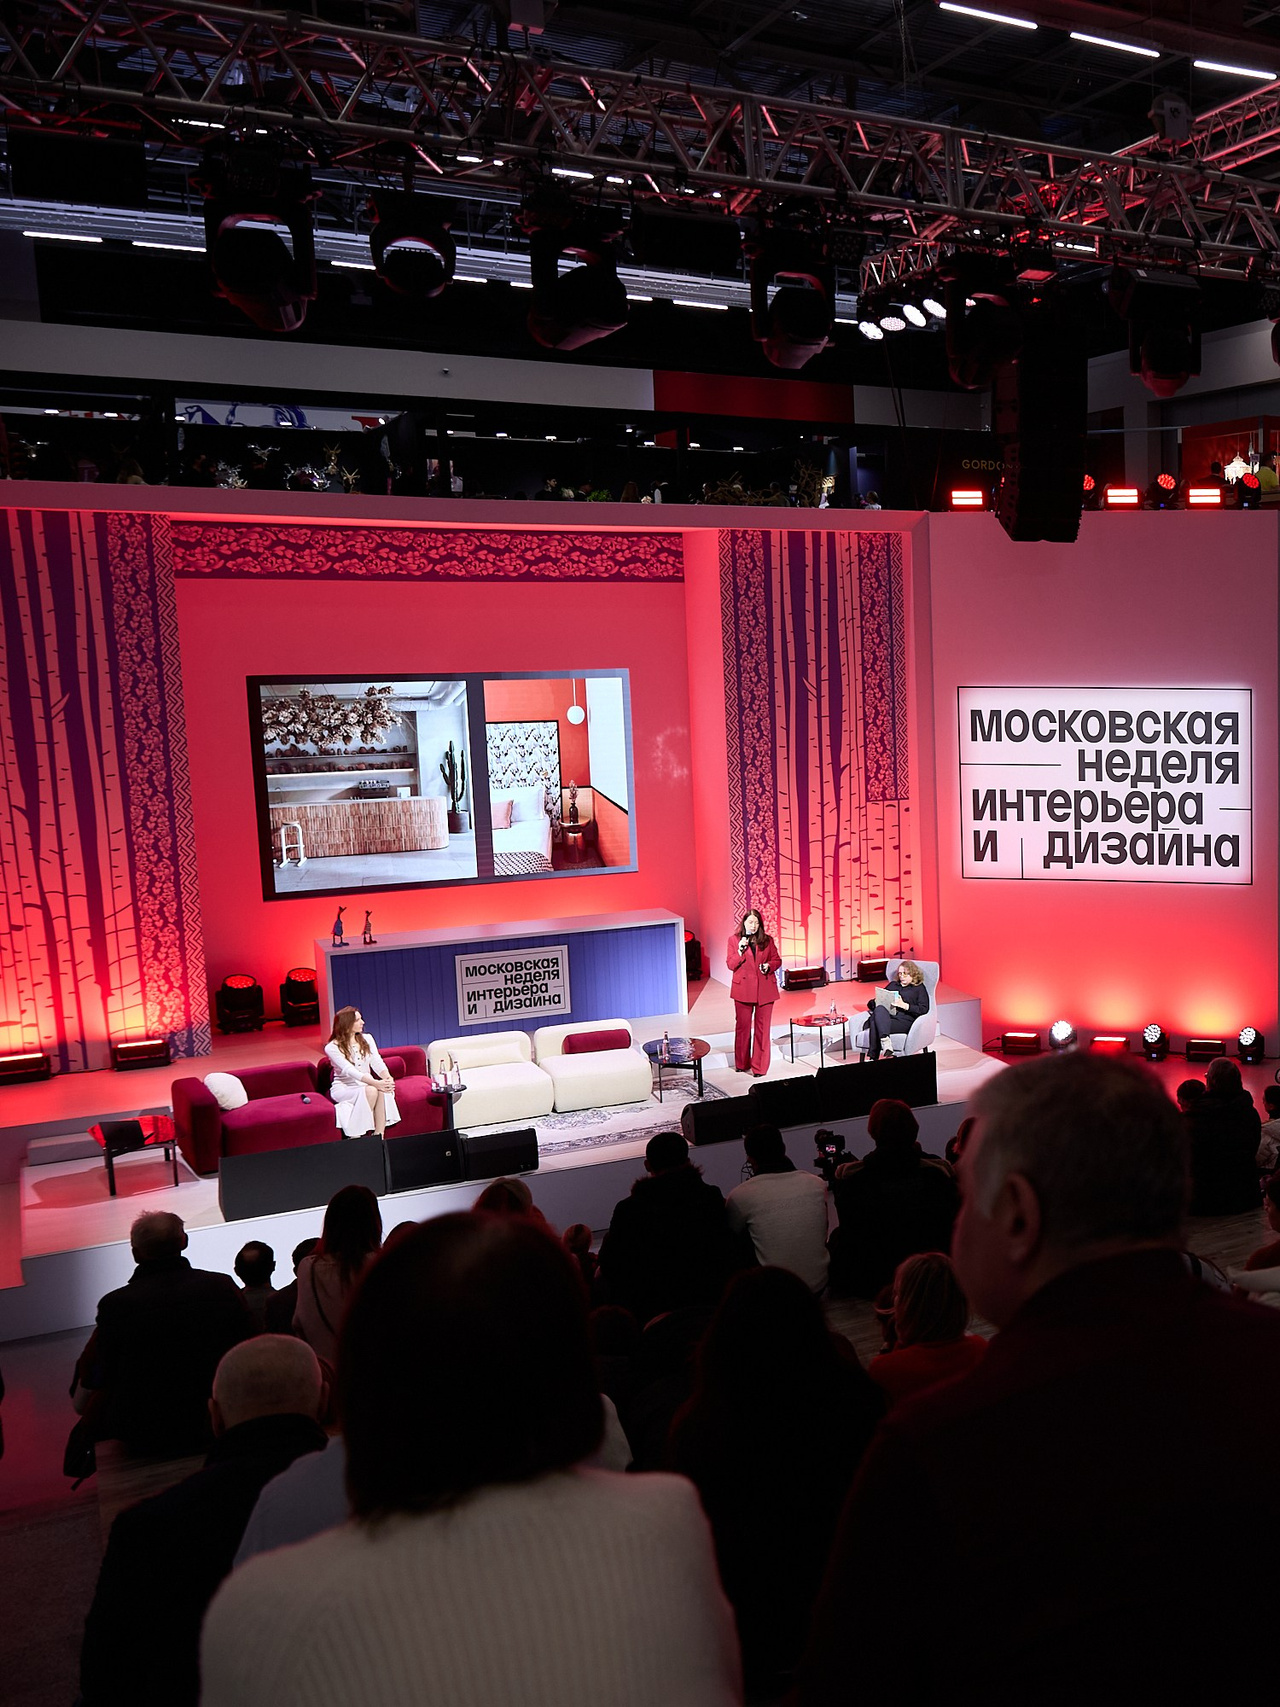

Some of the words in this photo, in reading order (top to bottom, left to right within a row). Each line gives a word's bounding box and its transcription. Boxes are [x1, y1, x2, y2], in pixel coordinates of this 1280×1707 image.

[970, 709, 1239, 744] московская
[1078, 749, 1240, 789] неделя
[972, 789, 1203, 831] интерьера
[973, 830, 998, 862] и
[1043, 827, 1240, 869] дизайна
[465, 957, 559, 977] московская
[504, 969, 560, 986] неделя
[467, 982, 549, 1002] интерьера
[493, 994, 561, 1013] дизайна
